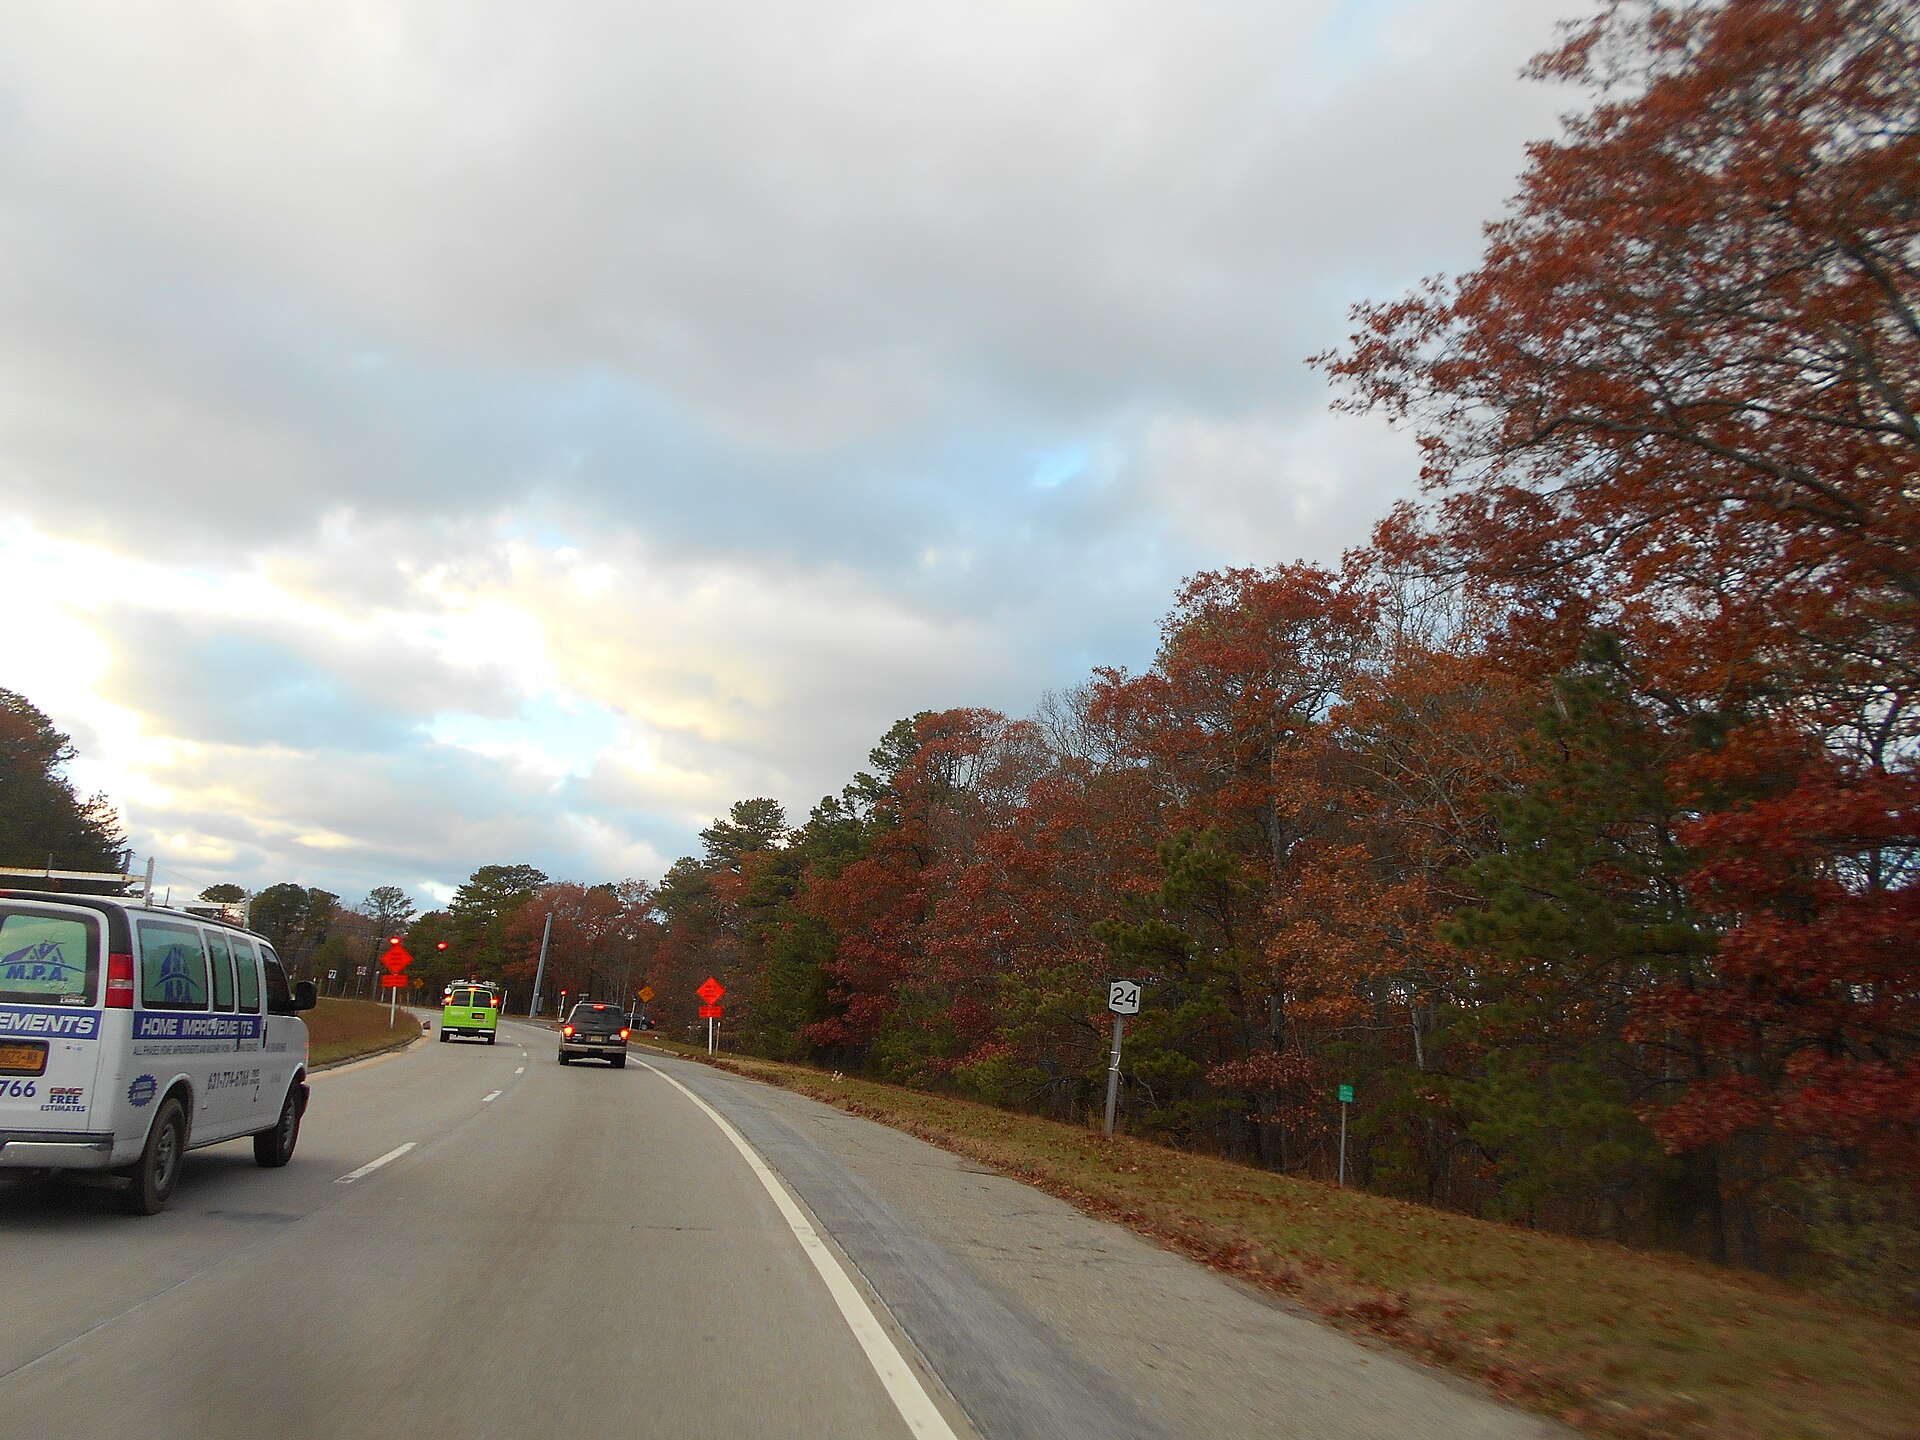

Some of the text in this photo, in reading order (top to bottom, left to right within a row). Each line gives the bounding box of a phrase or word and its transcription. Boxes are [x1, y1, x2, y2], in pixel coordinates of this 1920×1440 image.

[6, 965, 68, 981] M.P.A.
[1111, 986, 1137, 1008] 24
[0, 1012, 95, 1034] EMENTS
[140, 1018, 178, 1036] HOME
[0, 1080, 36, 1098] 766
[40, 1104, 86, 1112] ESTIMATES
[49, 1095, 79, 1105] FREE
